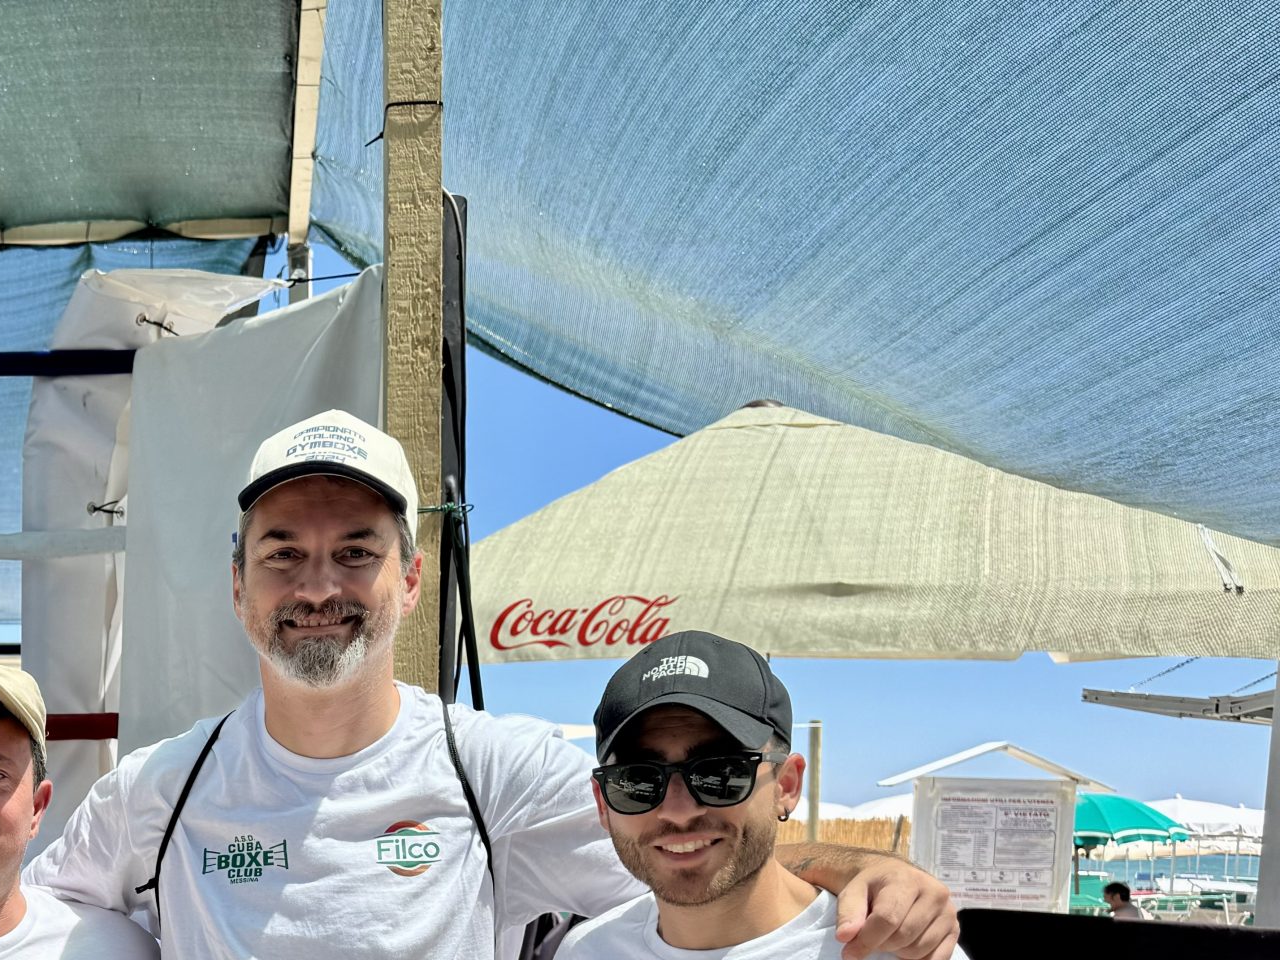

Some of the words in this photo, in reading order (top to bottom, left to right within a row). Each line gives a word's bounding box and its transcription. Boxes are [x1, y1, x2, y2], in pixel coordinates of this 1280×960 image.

[303, 433, 355, 444] ITALIANO
[286, 440, 368, 461] GYMBOXE
[490, 594, 680, 651] Coca-Cola
[661, 655, 686, 666] THE
[642, 661, 685, 680] NORTH
[652, 668, 684, 681] FACE
[234, 834, 255, 843] A.S.D.
[228, 841, 263, 853] CUBA
[376, 838, 440, 861] Filco
[217, 850, 274, 870] BOXE
[228, 867, 263, 879] CLUB
[230, 877, 259, 885] MESSINA
